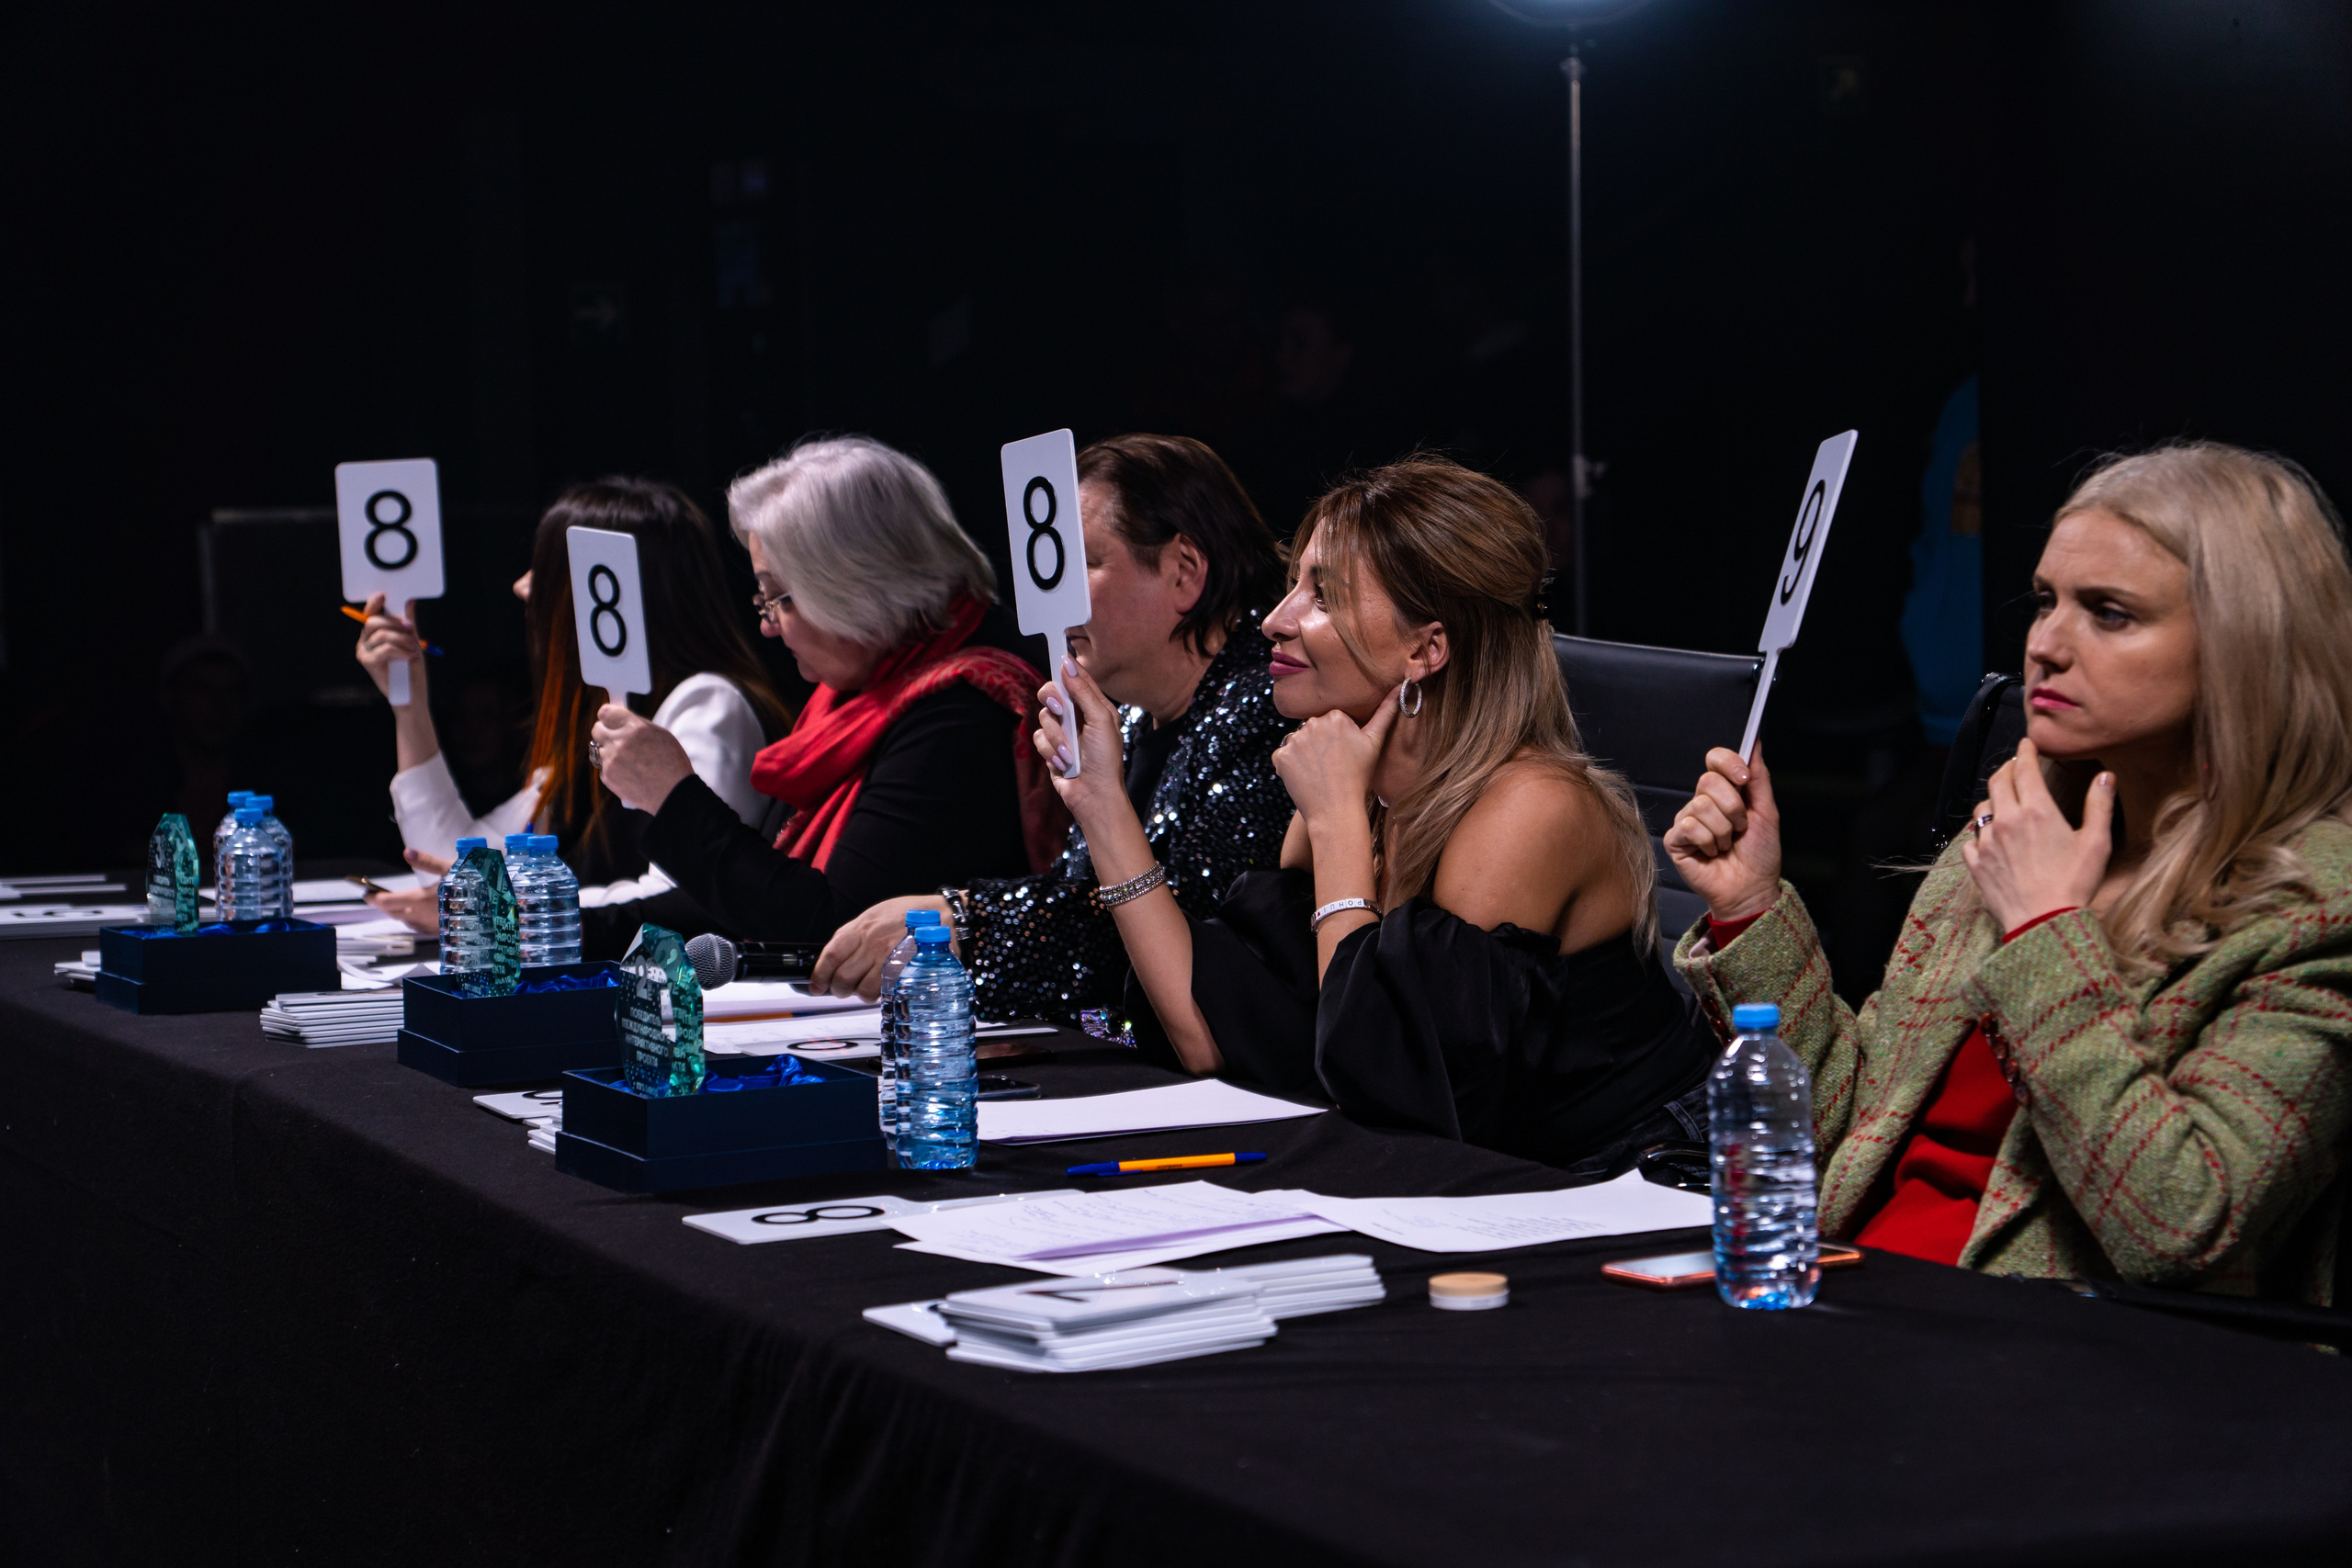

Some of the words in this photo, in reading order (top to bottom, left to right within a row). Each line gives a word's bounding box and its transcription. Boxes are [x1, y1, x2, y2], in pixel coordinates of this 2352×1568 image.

[364, 490, 418, 570] 8
[1023, 476, 1065, 591] 8
[1781, 479, 1826, 607] 9
[588, 563, 628, 657] 8
[635, 954, 648, 1000] 2
[752, 1205, 885, 1225] 8
